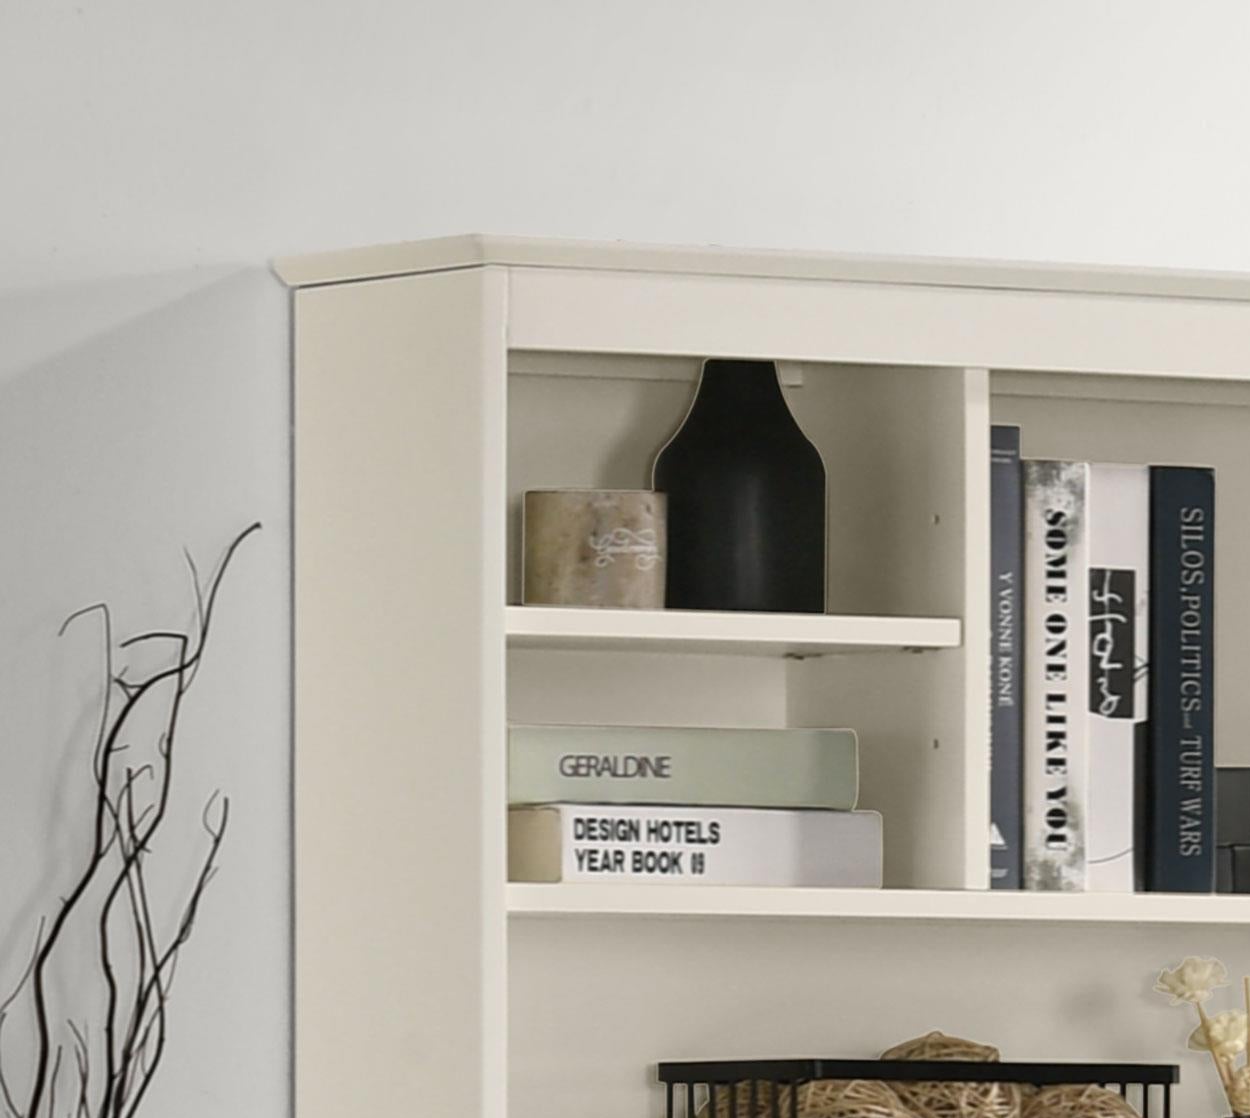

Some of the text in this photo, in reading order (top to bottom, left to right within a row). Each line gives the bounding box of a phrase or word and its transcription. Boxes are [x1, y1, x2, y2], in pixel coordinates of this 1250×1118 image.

[1045, 508, 1067, 851] SOME ONE LIKE YOU
[559, 755, 672, 778] GERALDINE
[1179, 735, 1203, 792] TURF
[573, 818, 721, 844] DESIGN HOTELS
[1179, 797, 1203, 857] WARS
[574, 849, 625, 873] YEAR
[632, 851, 683, 874] BOOK
